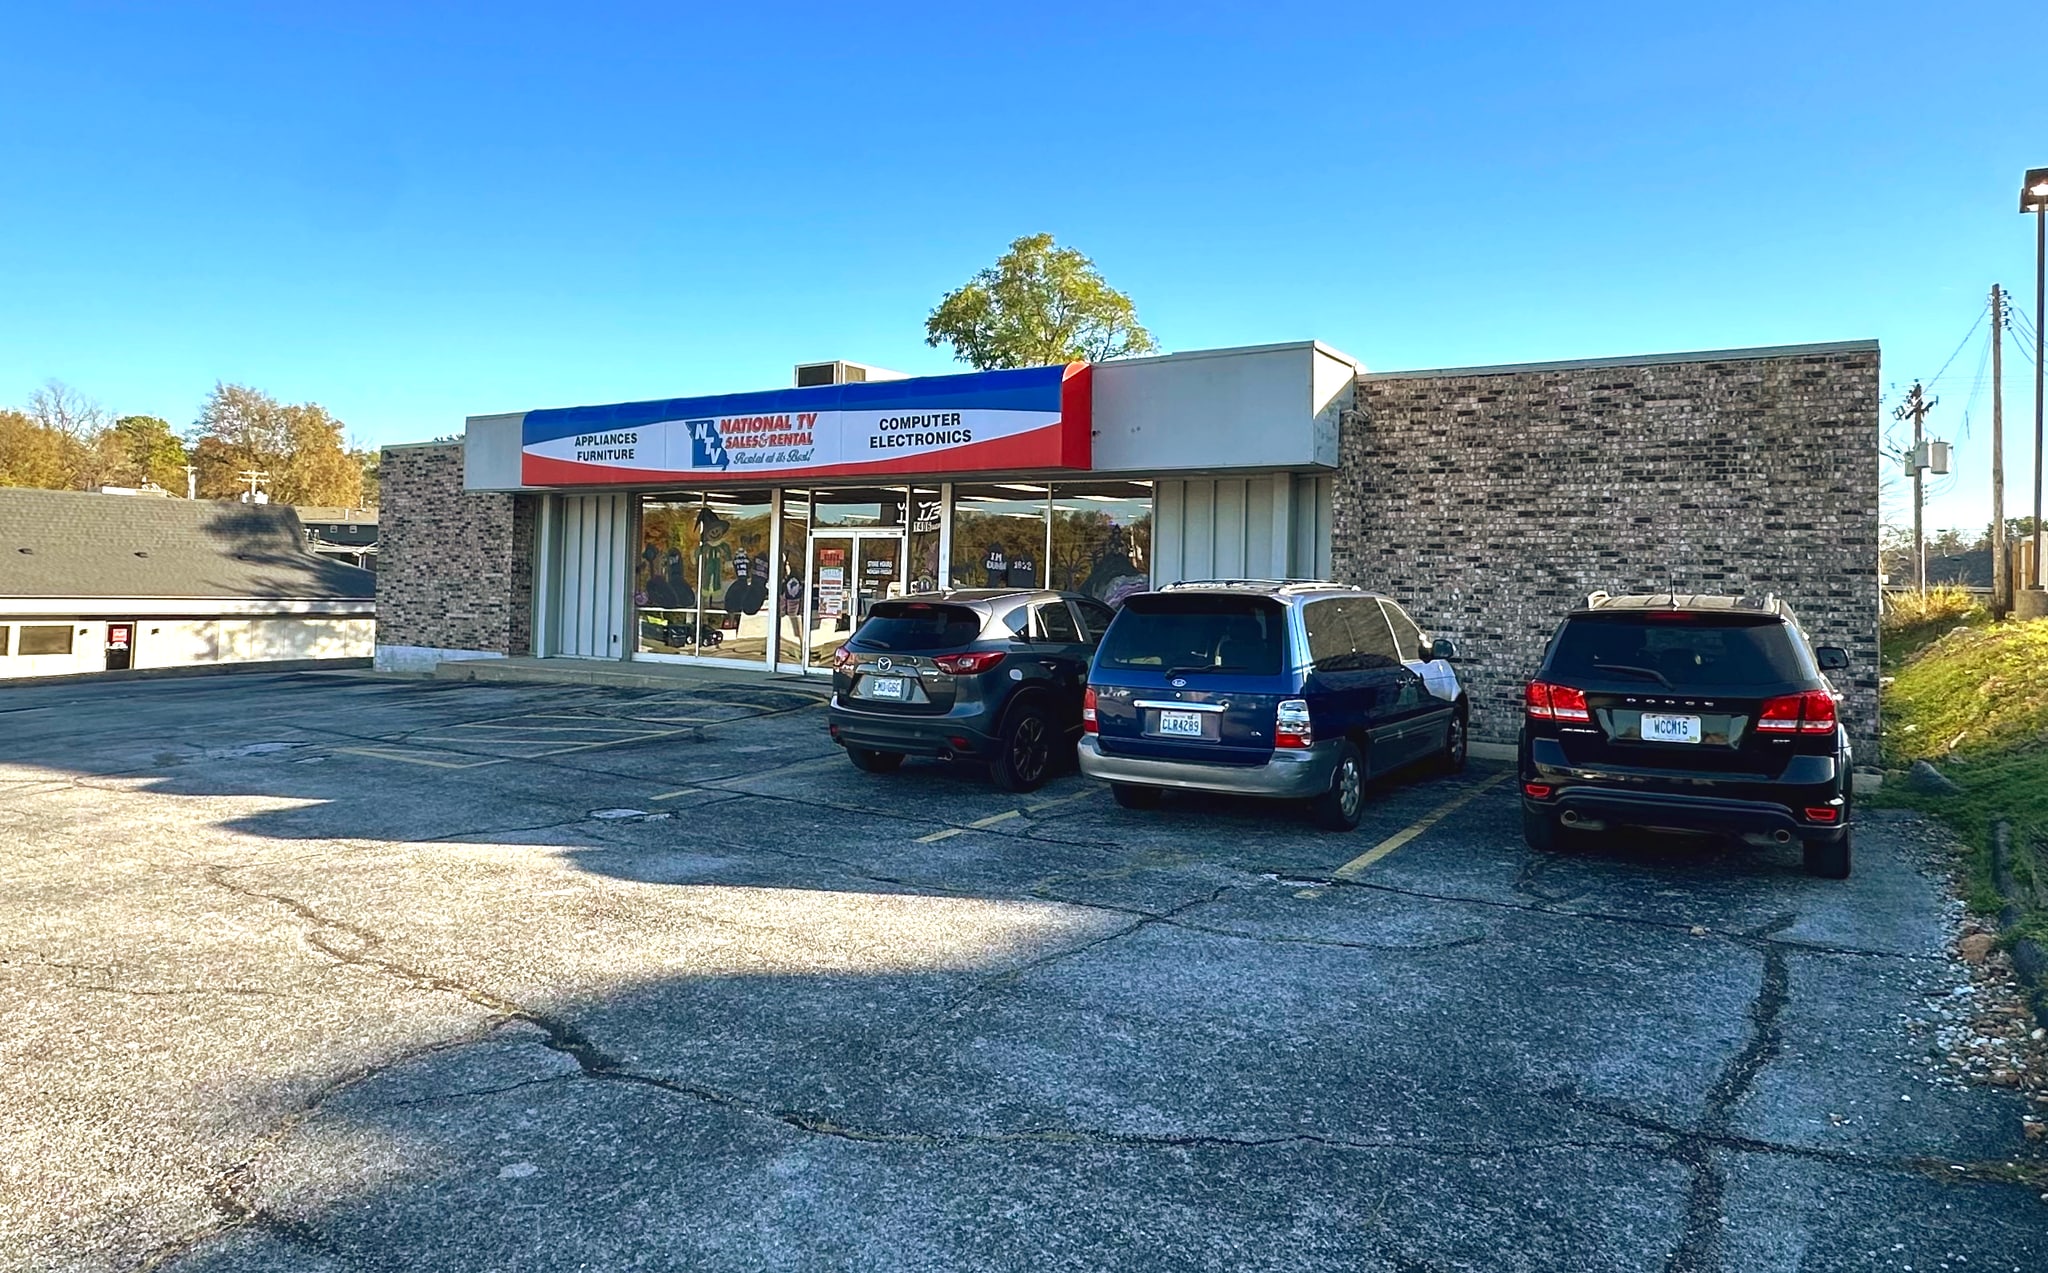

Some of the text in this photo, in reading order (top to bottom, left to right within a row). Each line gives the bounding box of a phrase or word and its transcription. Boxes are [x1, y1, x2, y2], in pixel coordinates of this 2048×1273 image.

[720, 413, 817, 434] NATIONAL TV
[880, 413, 960, 431] COMPUTER
[575, 433, 637, 447] APPLIANCES
[870, 430, 972, 448] ELECTRONICS
[577, 449, 635, 461] FURNITURE
[1162, 718, 1199, 732] CLR4289
[1654, 719, 1688, 735] WCCM15
